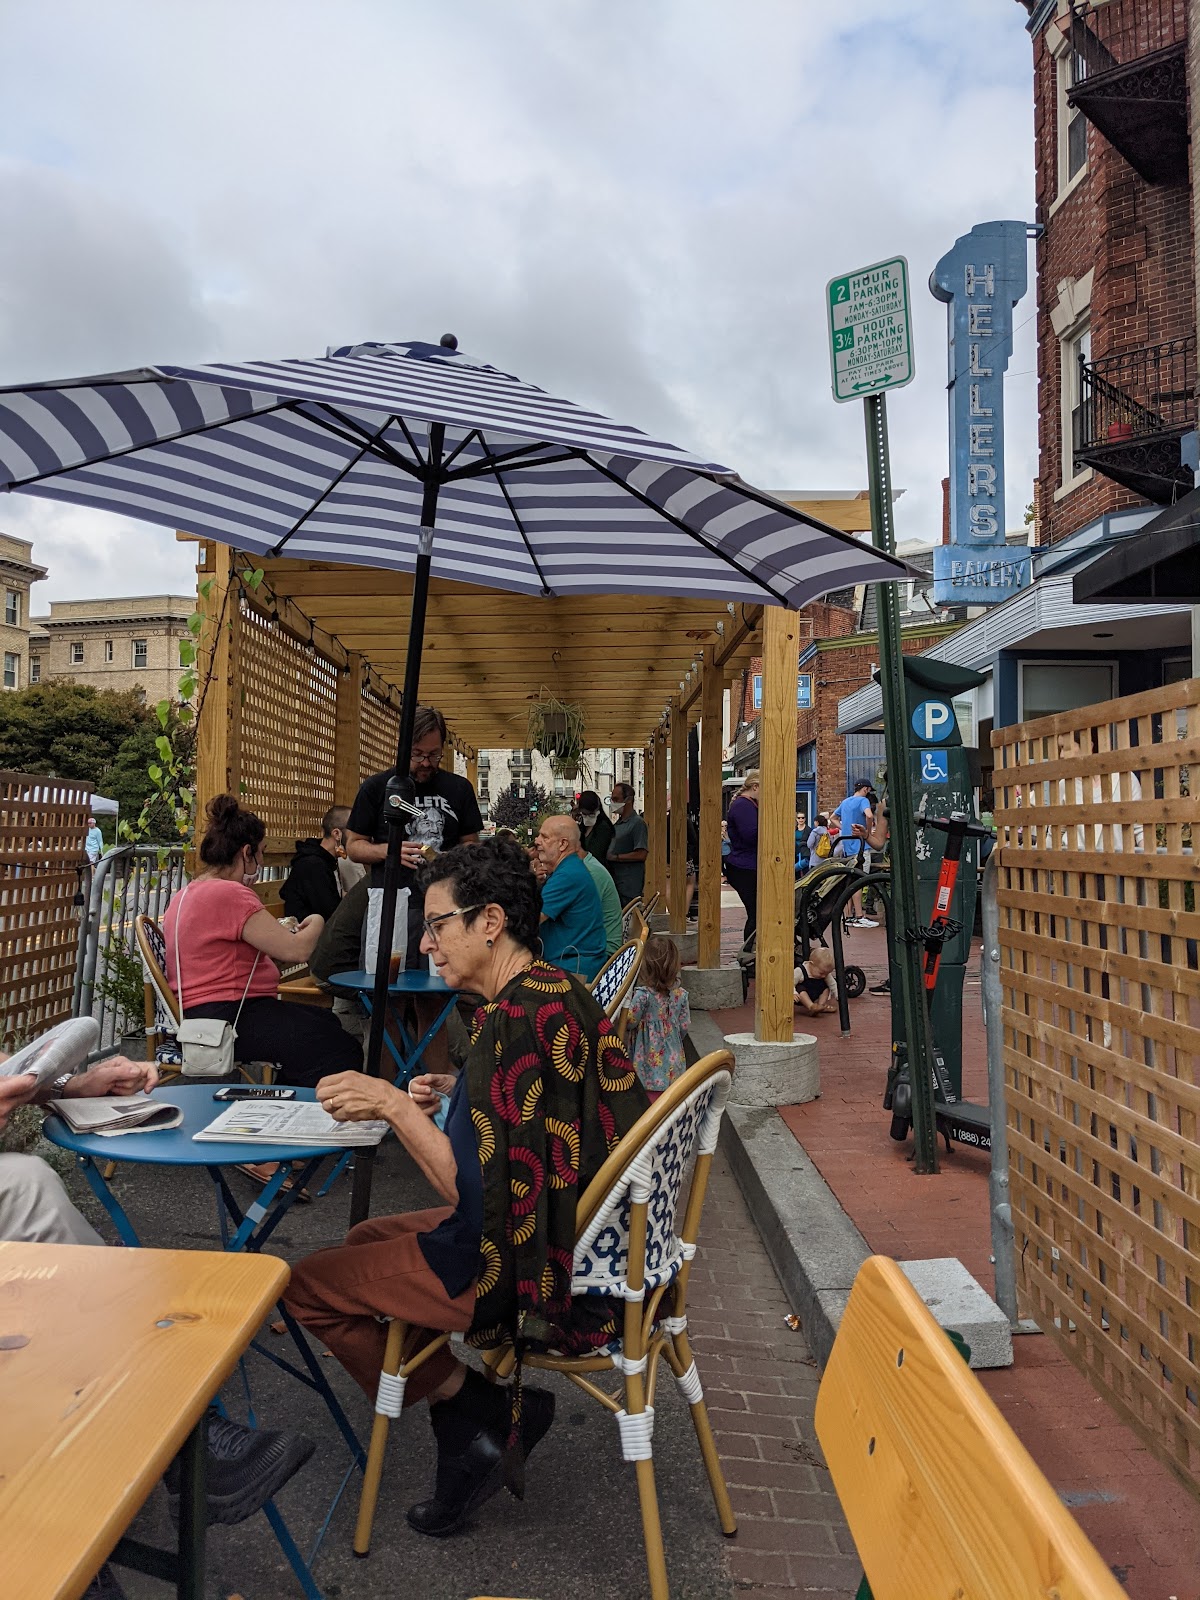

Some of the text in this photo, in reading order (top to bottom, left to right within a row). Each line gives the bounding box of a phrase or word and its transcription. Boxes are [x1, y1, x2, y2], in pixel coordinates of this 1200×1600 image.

[852, 269, 889, 289] HOUR
[853, 278, 899, 301] PARKING
[837, 285, 846, 302] 2
[848, 291, 897, 313] 7AM-6:30PM
[844, 299, 902, 324] MONDAY-SATURDAY
[857, 323, 904, 346] PARKING
[862, 316, 893, 334] HOUR
[847, 344, 903, 367] MONDAY-SATURDAY
[850, 335, 902, 358] 6:30PM-10PM
[864, 369, 882, 377] TIMES
[884, 362, 904, 372] ABOVE
[875, 359, 894, 368] PARK
[964, 264, 998, 537] HELLERS
[951, 560, 1025, 587] BAKERY
[925, 702, 949, 739] P
[952, 1128, 992, 1147] 1 (888) 24
